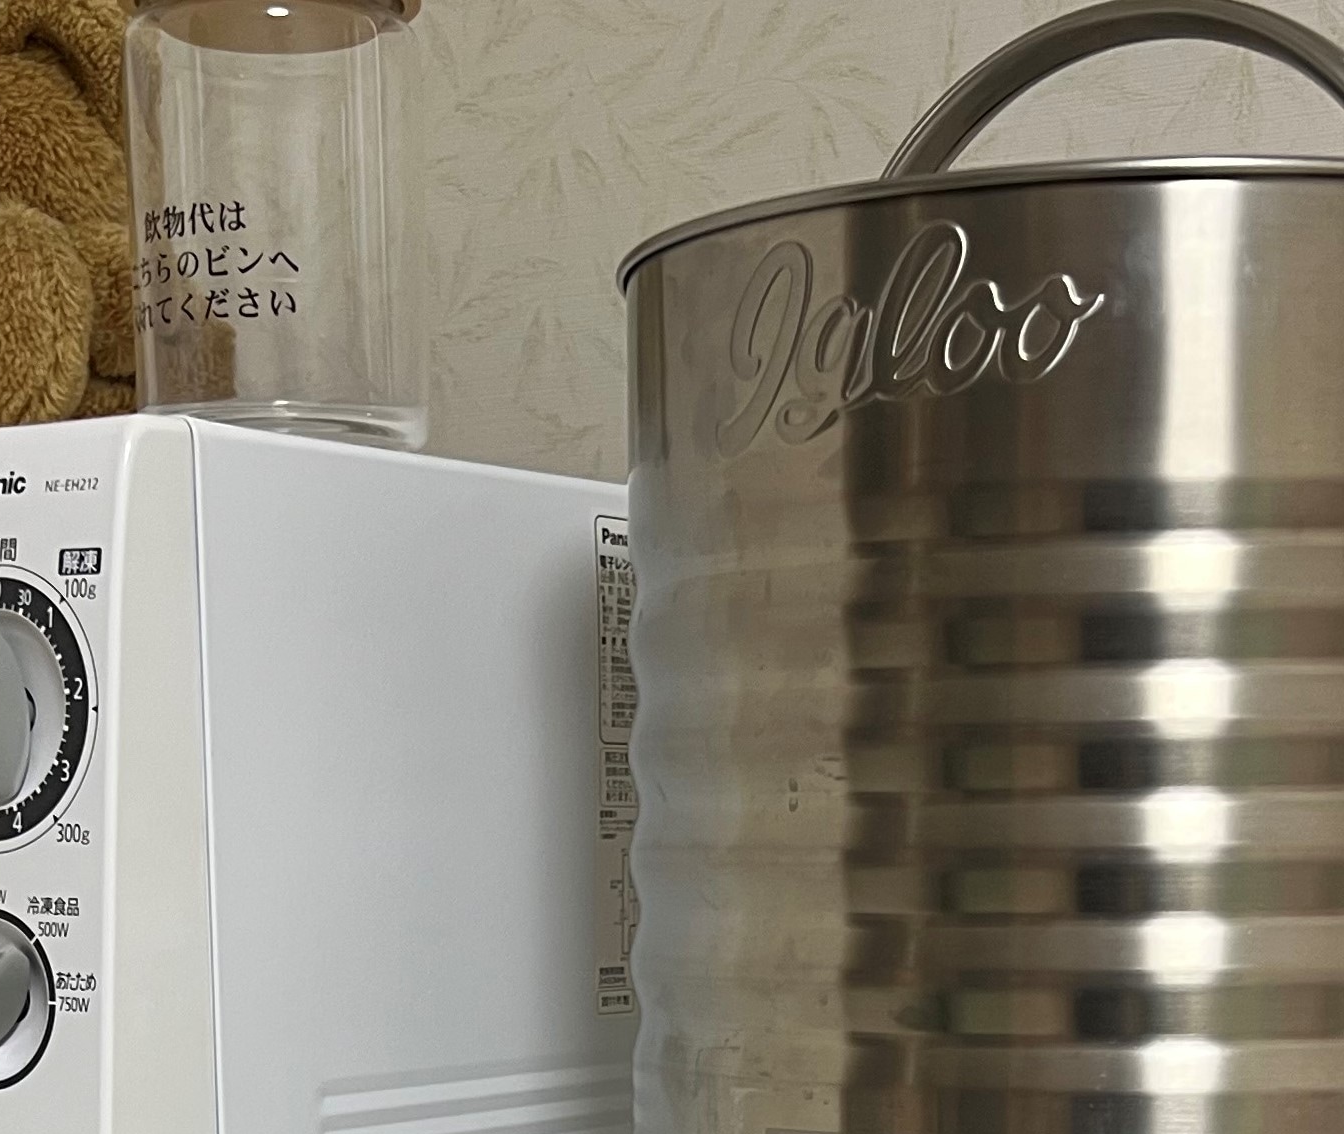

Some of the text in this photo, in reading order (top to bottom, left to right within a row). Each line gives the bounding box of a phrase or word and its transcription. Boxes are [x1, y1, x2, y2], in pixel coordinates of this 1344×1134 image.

[144, 201, 246, 243] 飲物代は
[136, 287, 297, 333] れてください
[716, 219, 1104, 458] Igloo
[44, 477, 99, 493] NE-EH212
[61, 550, 98, 574] 解凍
[17, 589, 31, 606] 30
[63, 578, 97, 600] 100g
[46, 606, 54, 629] 1
[73, 678, 83, 701] 2
[60, 760, 70, 782] 3
[12, 811, 23, 833] 4
[56, 823, 90, 845] 300g
[27, 896, 79, 916] 冷凍食品
[38, 922, 69, 938] 500W
[55, 972, 97, 991] あたため
[58, 996, 90, 1012] 750W
